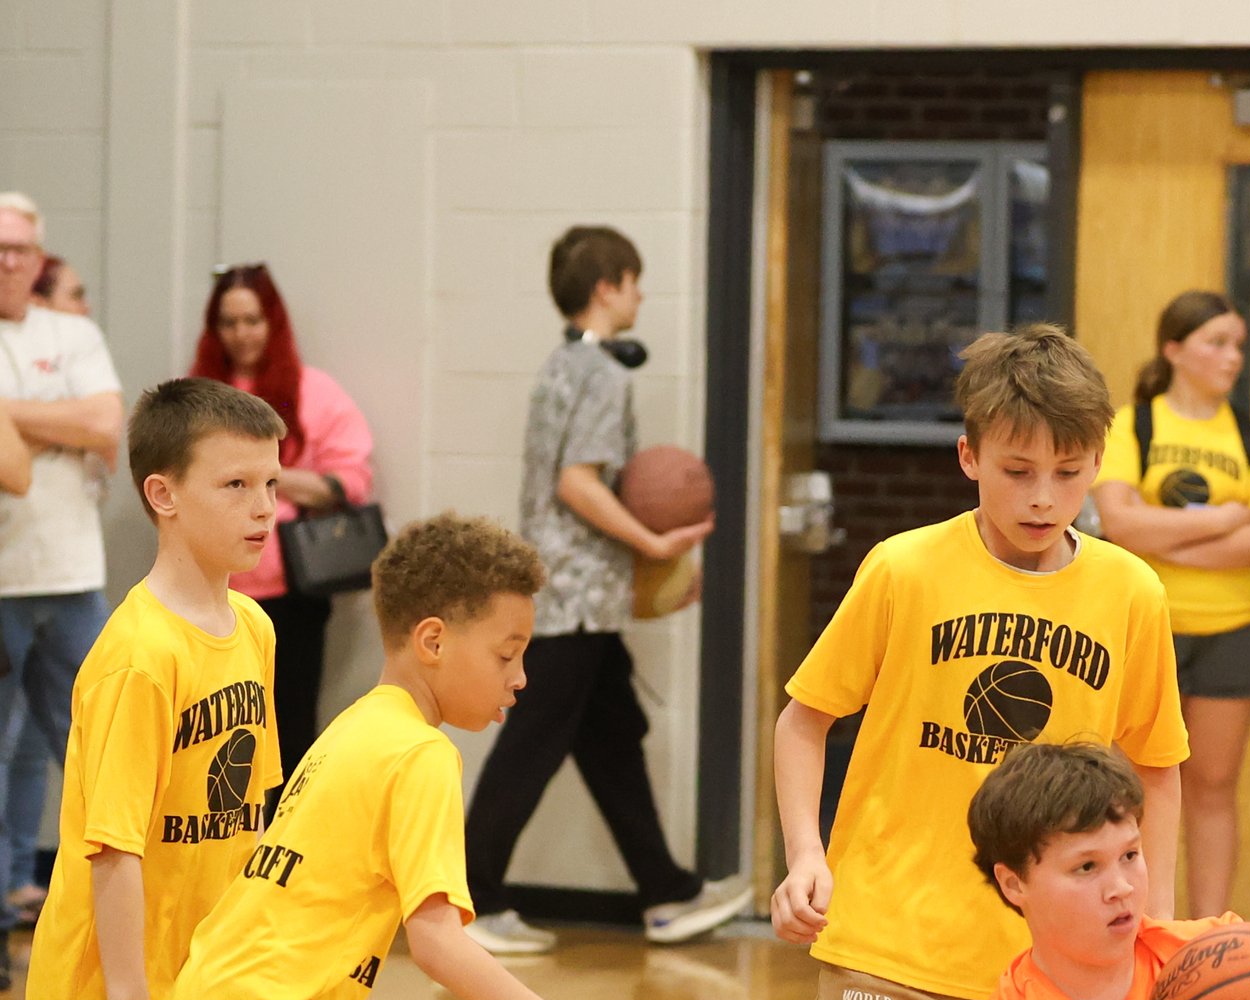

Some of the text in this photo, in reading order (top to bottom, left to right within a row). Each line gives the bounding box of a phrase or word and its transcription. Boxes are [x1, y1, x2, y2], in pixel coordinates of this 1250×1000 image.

[931, 612, 1110, 691] WATERFORD
[172, 680, 267, 754] WATERFO
[919, 721, 1032, 765] BASKET
